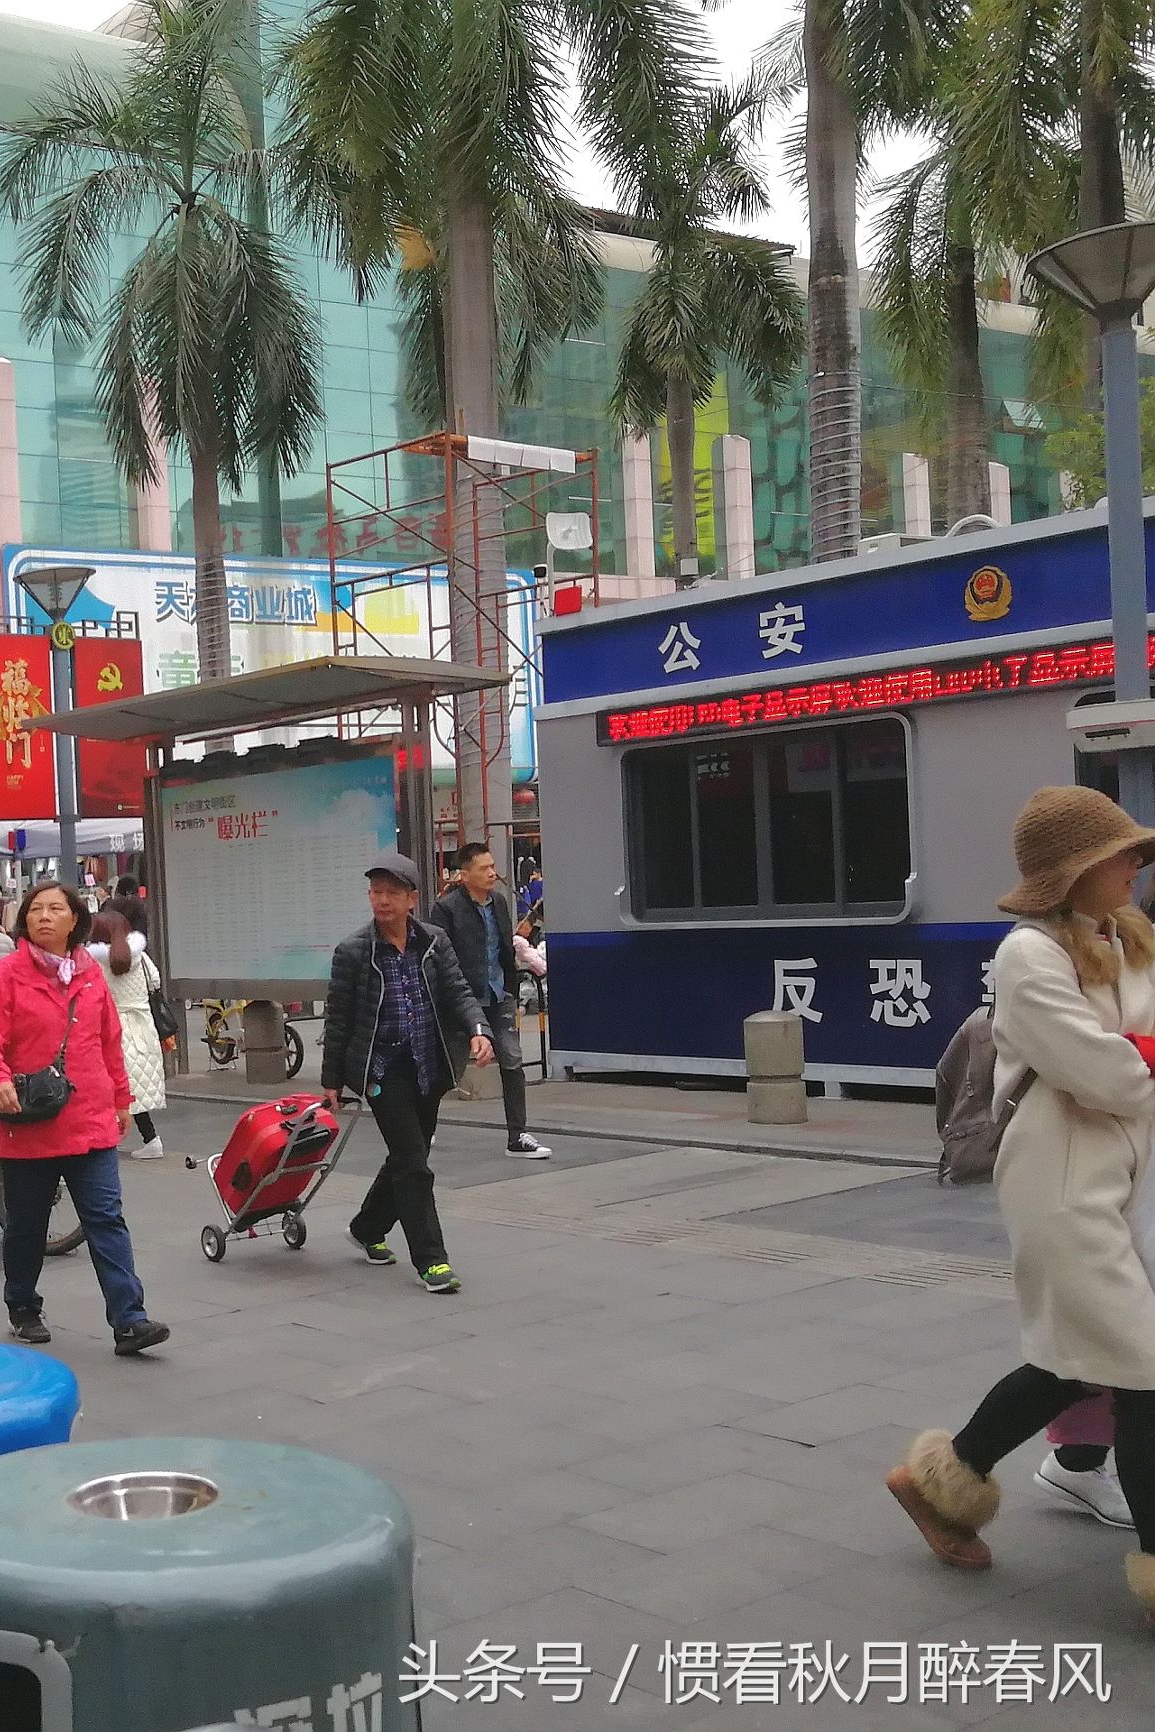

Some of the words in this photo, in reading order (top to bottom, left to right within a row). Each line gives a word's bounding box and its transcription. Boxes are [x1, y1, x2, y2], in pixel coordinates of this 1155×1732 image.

[154, 580, 317, 625] 天商业城
[658, 602, 806, 674] 公安
[772, 957, 996, 1028] 反恐
